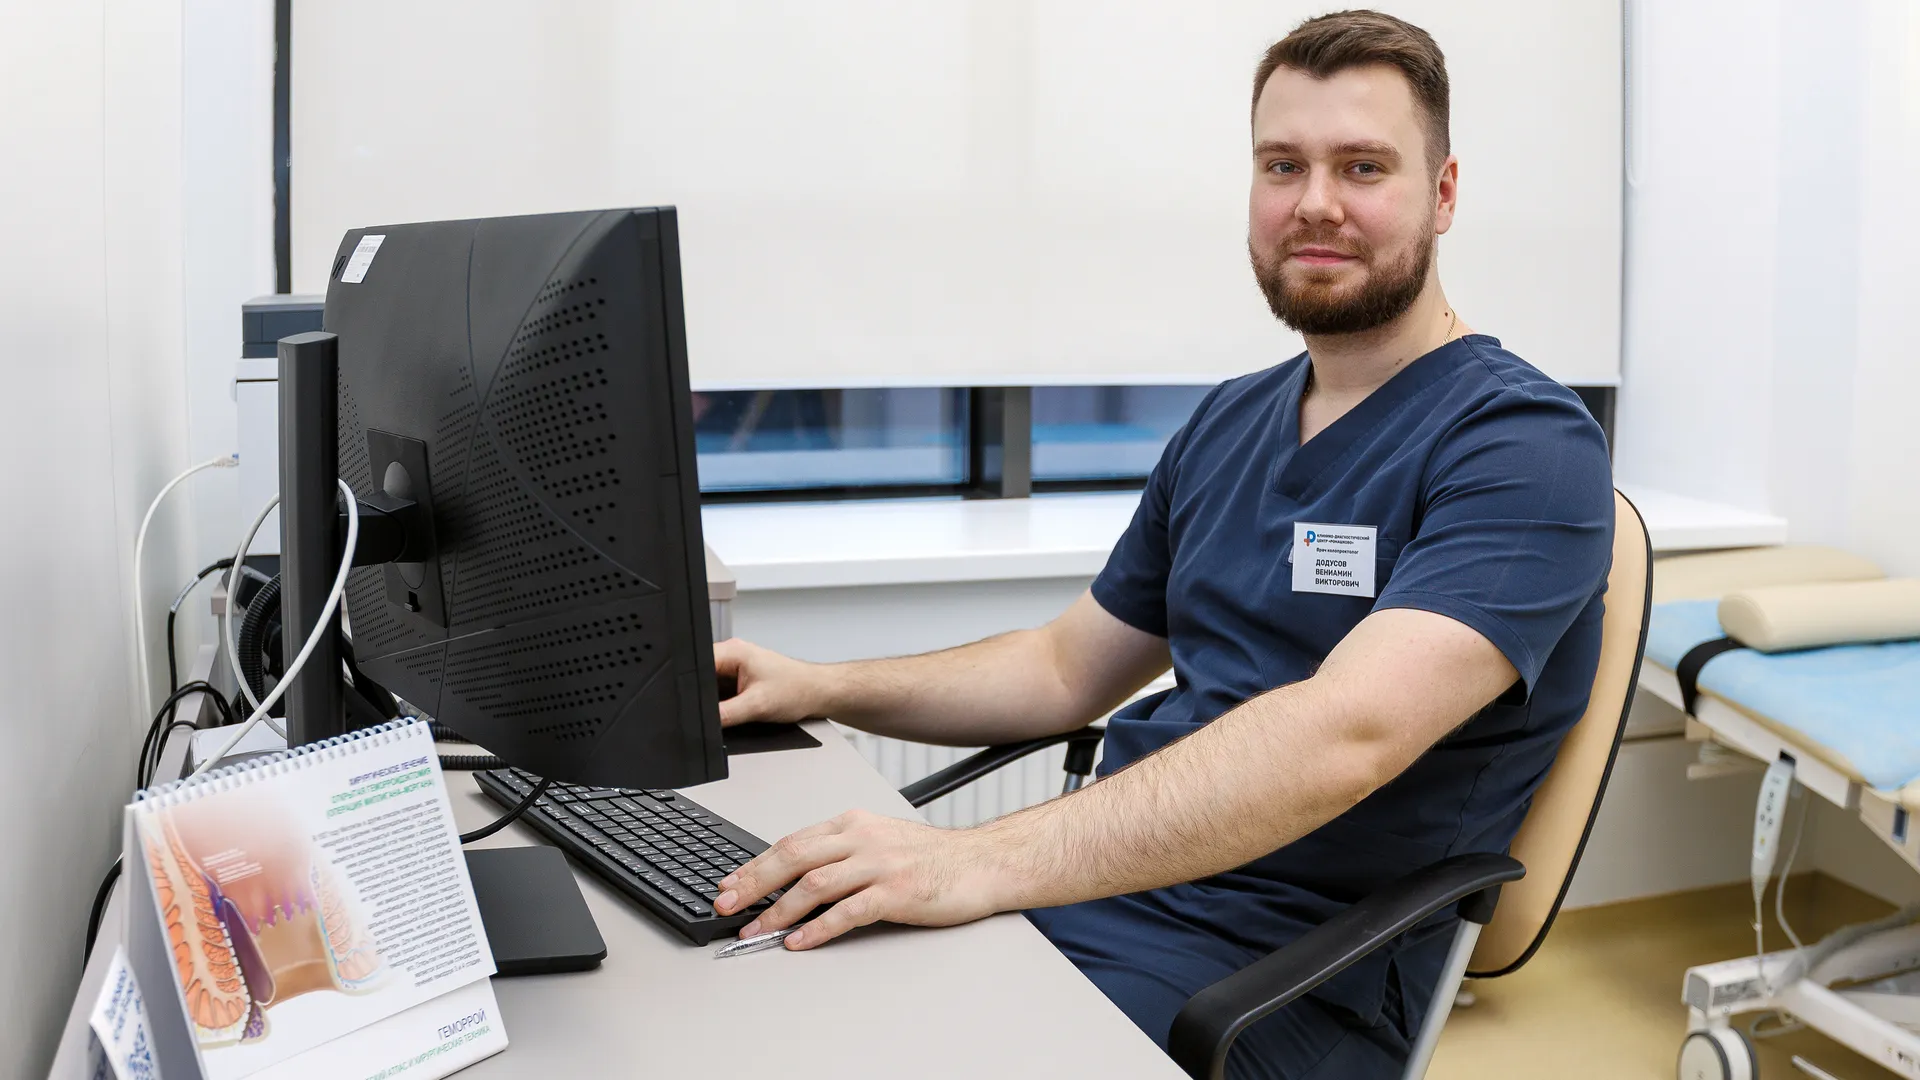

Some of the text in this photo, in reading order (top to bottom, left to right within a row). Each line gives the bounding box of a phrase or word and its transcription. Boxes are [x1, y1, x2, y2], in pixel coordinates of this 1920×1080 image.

[1315, 559, 1347, 568] ДОДУСОВ
[1315, 568, 1352, 578] ВЕНИАМИН
[1315, 578, 1360, 588] ВИКТОРОВИЧ
[437, 1008, 487, 1041] ГЕМОРРОЙ
[413, 1036, 463, 1064] ХИРУРГИЧЕСКАЯ
[464, 1025, 491, 1042] ТЕХНИКА
